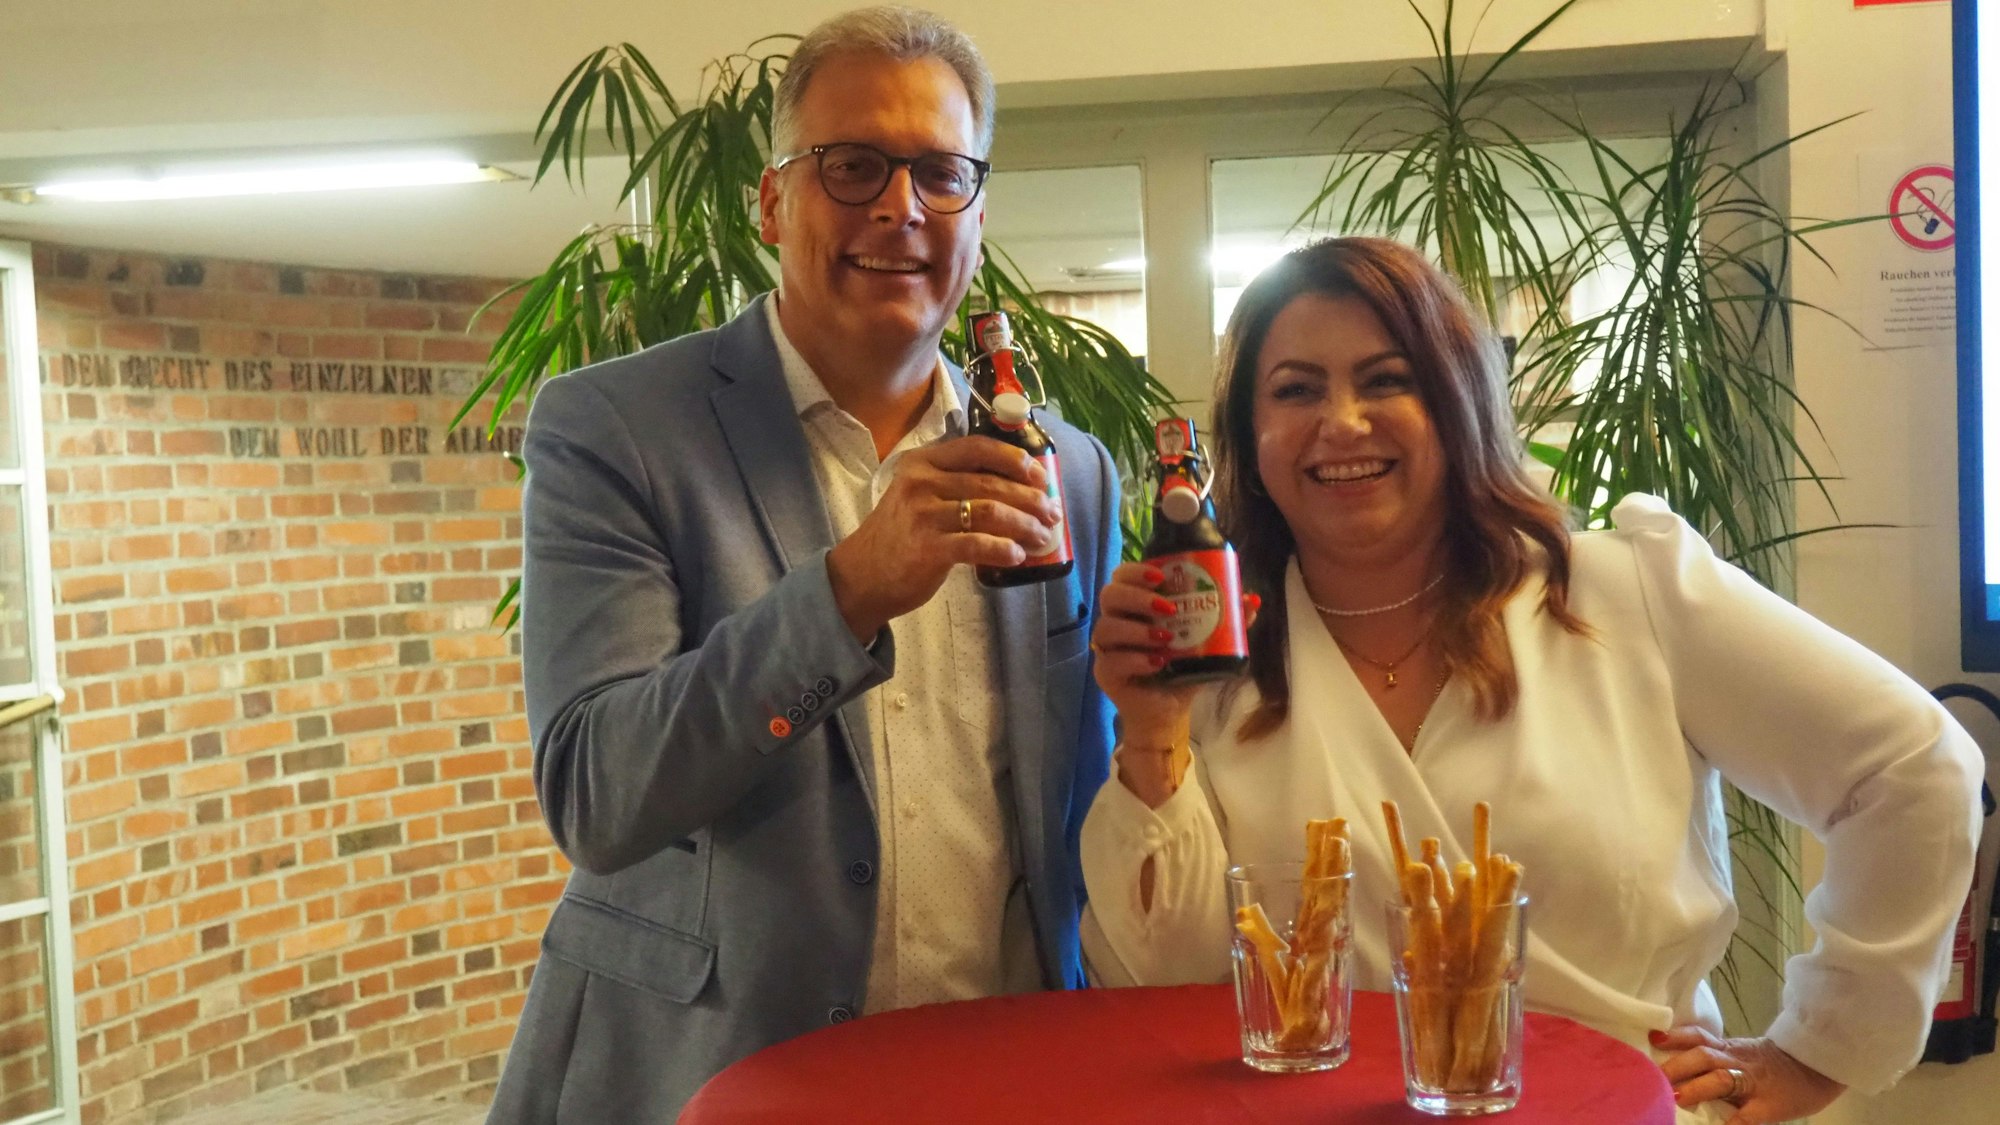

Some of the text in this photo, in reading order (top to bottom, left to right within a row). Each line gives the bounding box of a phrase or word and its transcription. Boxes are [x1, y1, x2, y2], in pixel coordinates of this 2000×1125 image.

[1880, 270, 1930, 281] Rauchen
[62, 353, 116, 388] DEM
[126, 355, 211, 390] RECHT
[224, 360, 273, 391] DES
[289, 361, 433, 395] EINZELNEN
[230, 427, 280, 458] DEM
[294, 425, 368, 457] WOHL
[380, 426, 428, 455] DER
